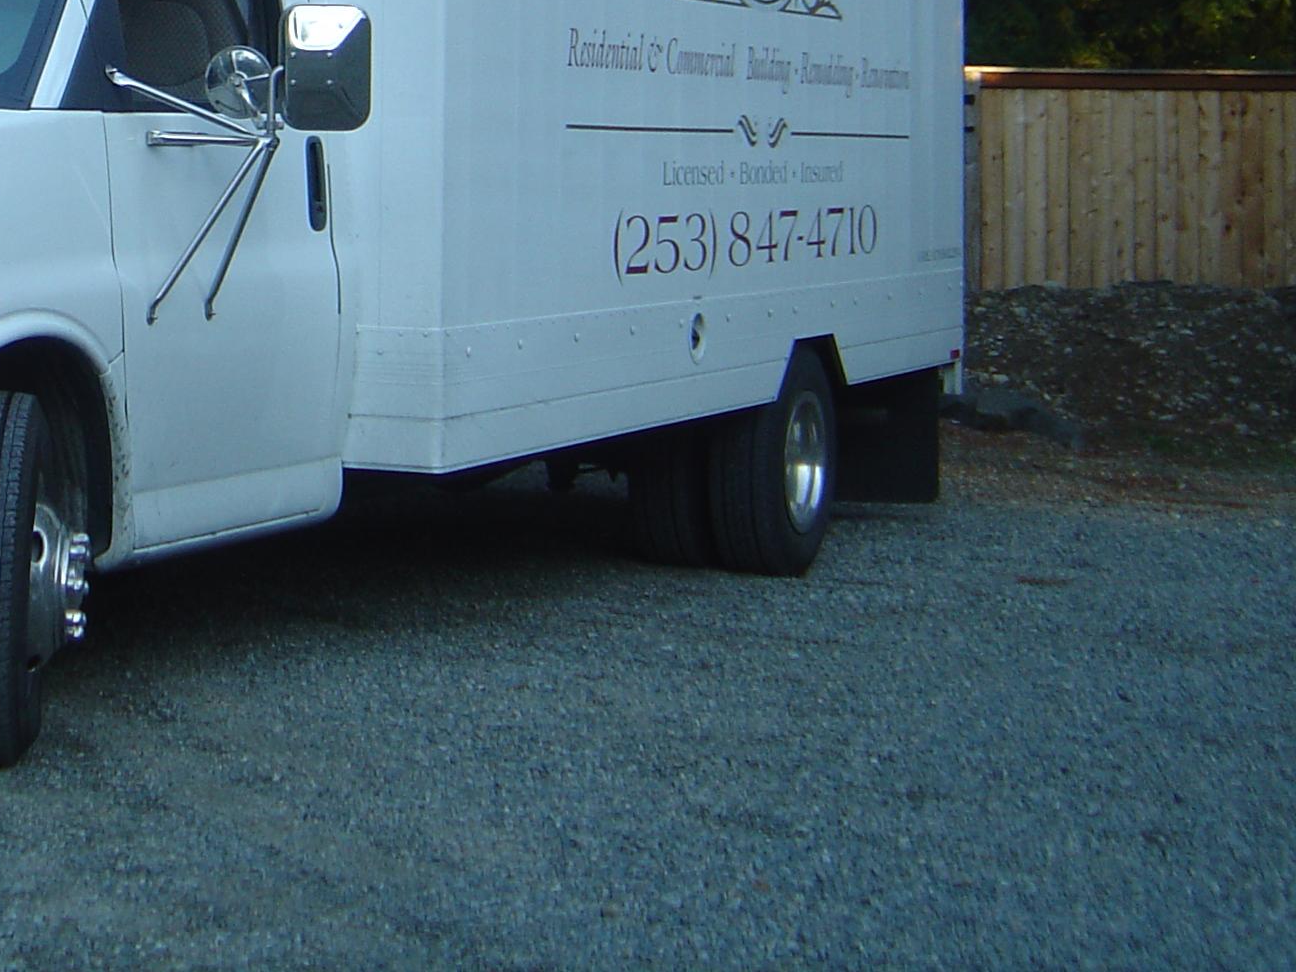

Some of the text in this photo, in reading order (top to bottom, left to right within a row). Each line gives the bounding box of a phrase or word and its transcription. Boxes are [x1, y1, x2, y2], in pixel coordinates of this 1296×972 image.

[567, 27, 645, 71] Residential
[647, 36, 664, 73] &
[666, 37, 737, 77] Commercial
[746, 46, 792, 95] Building
[663, 159, 844, 186] Licensed Bonded Insured
[613, 204, 878, 286] (253) 847-4710
